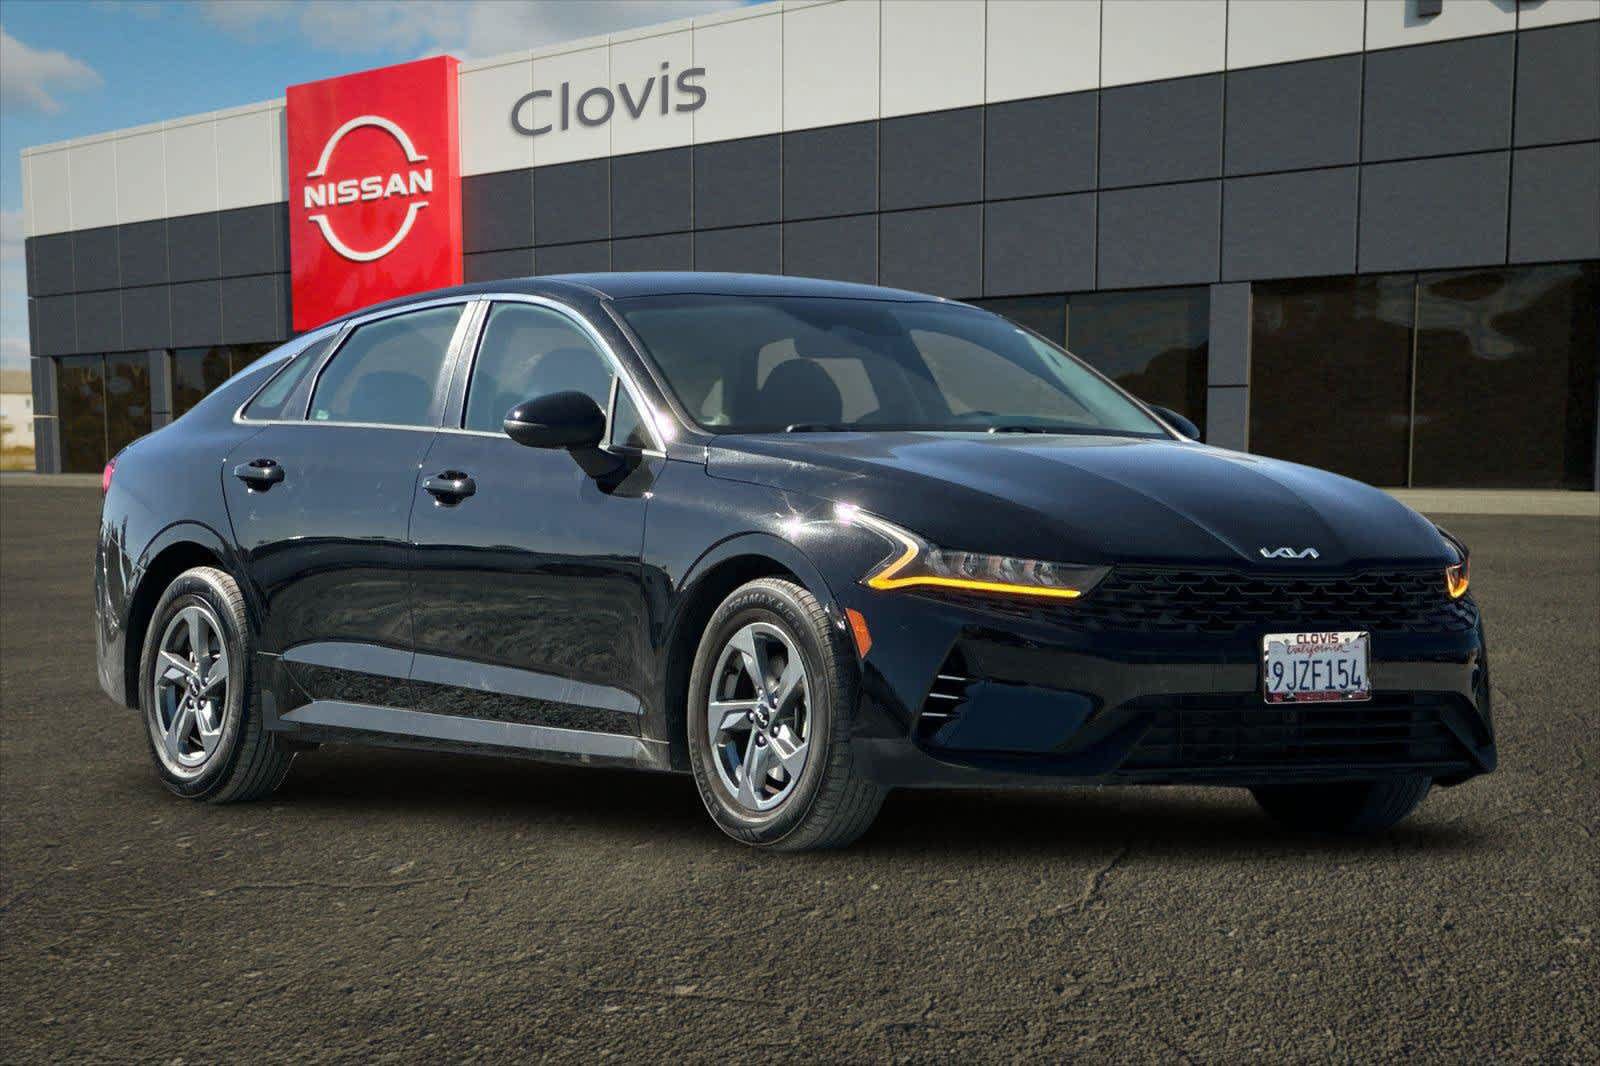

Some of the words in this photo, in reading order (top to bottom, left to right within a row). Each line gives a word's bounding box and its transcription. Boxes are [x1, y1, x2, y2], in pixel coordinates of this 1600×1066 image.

[511, 62, 707, 137] Clovis
[304, 168, 433, 208] NISSAN
[1296, 633, 1339, 645] CLOVIS
[1272, 659, 1362, 691] 9JZF154
